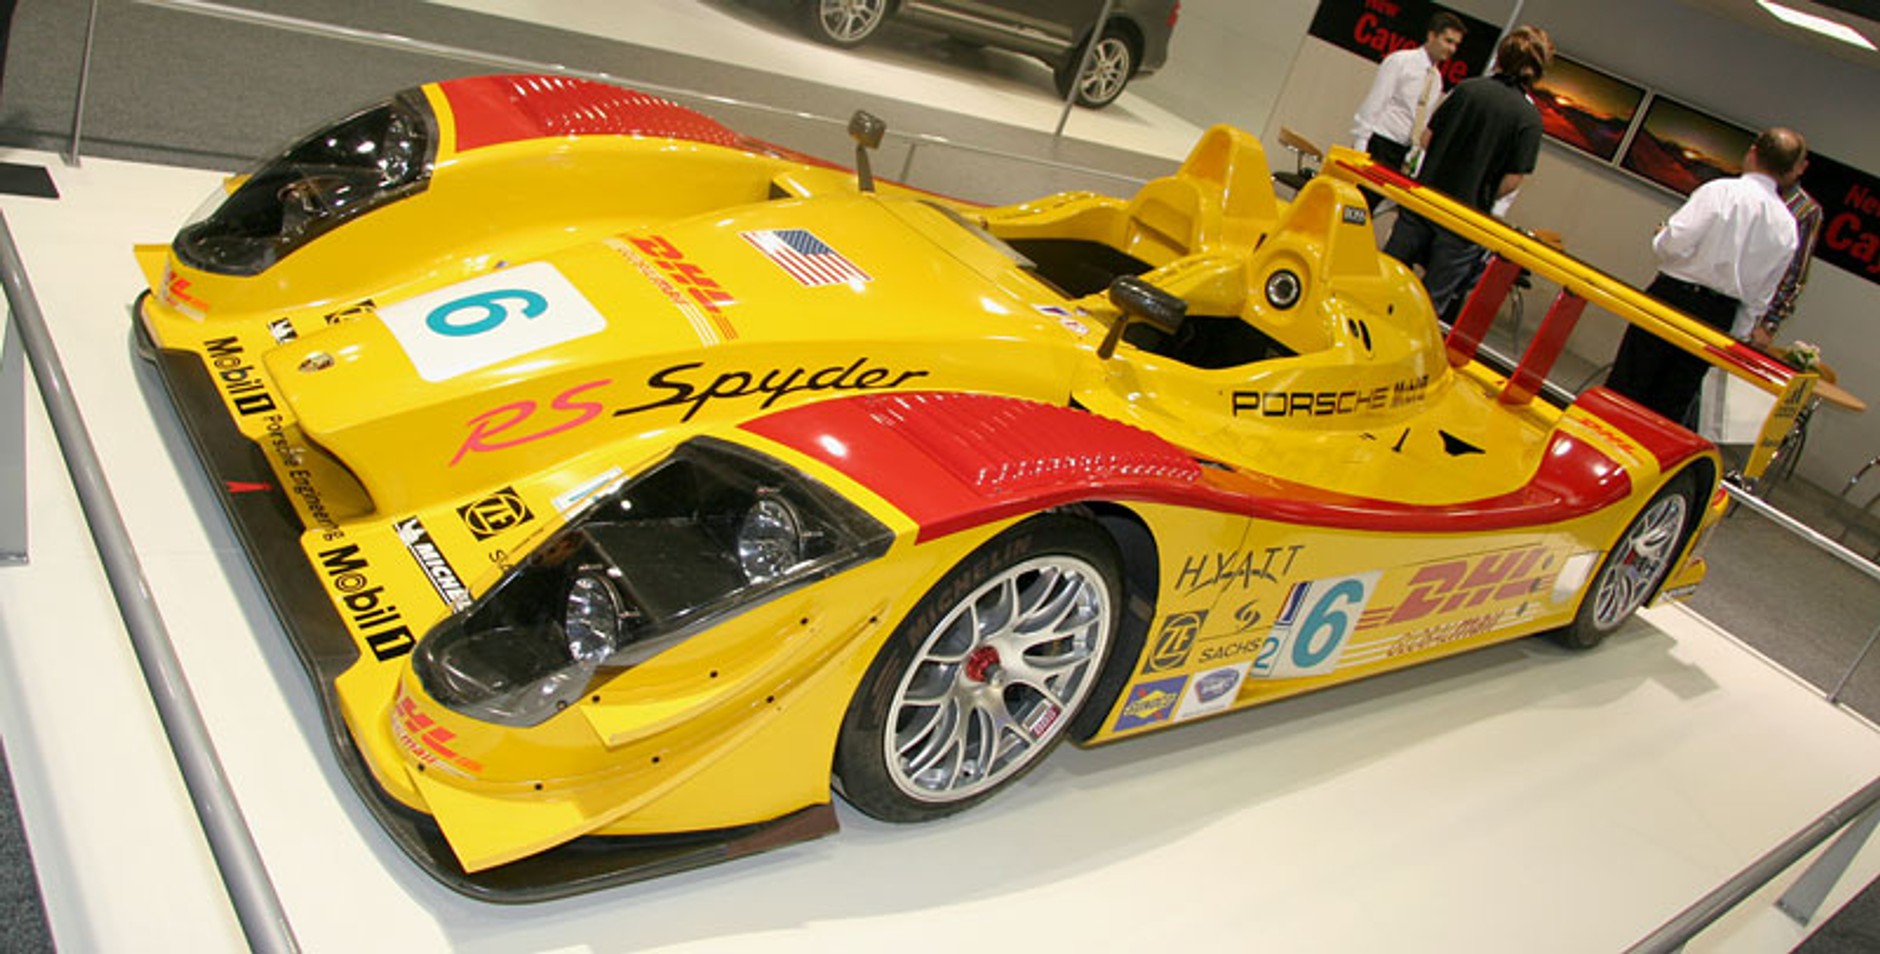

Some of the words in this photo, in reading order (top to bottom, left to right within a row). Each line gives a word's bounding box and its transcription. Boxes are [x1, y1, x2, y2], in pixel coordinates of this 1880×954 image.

[1353, 12, 1469, 84] Cayee
[1844, 183, 1880, 217] Ne
[626, 235, 735, 313] DHL
[203, 336, 264, 402] Mobil
[1232, 387, 1390, 417] PORSCHE
[450, 378, 612, 467] RS
[613, 357, 930, 422] Spyder
[264, 414, 300, 467] Porsche
[288, 470, 345, 541] Engineering
[473, 494, 517, 534] ZF
[318, 544, 401, 630] Mobil
[367, 626, 416, 662] 1
[907, 536, 1032, 648] MICHELIN
[1174, 545, 1305, 597] HYATT
[1386, 545, 1548, 624] DHL
[1152, 624, 1197, 660] ZF
[1198, 637, 1263, 663] SACHS
[1253, 637, 1280, 669] 2
[1292, 577, 1365, 669] 6
